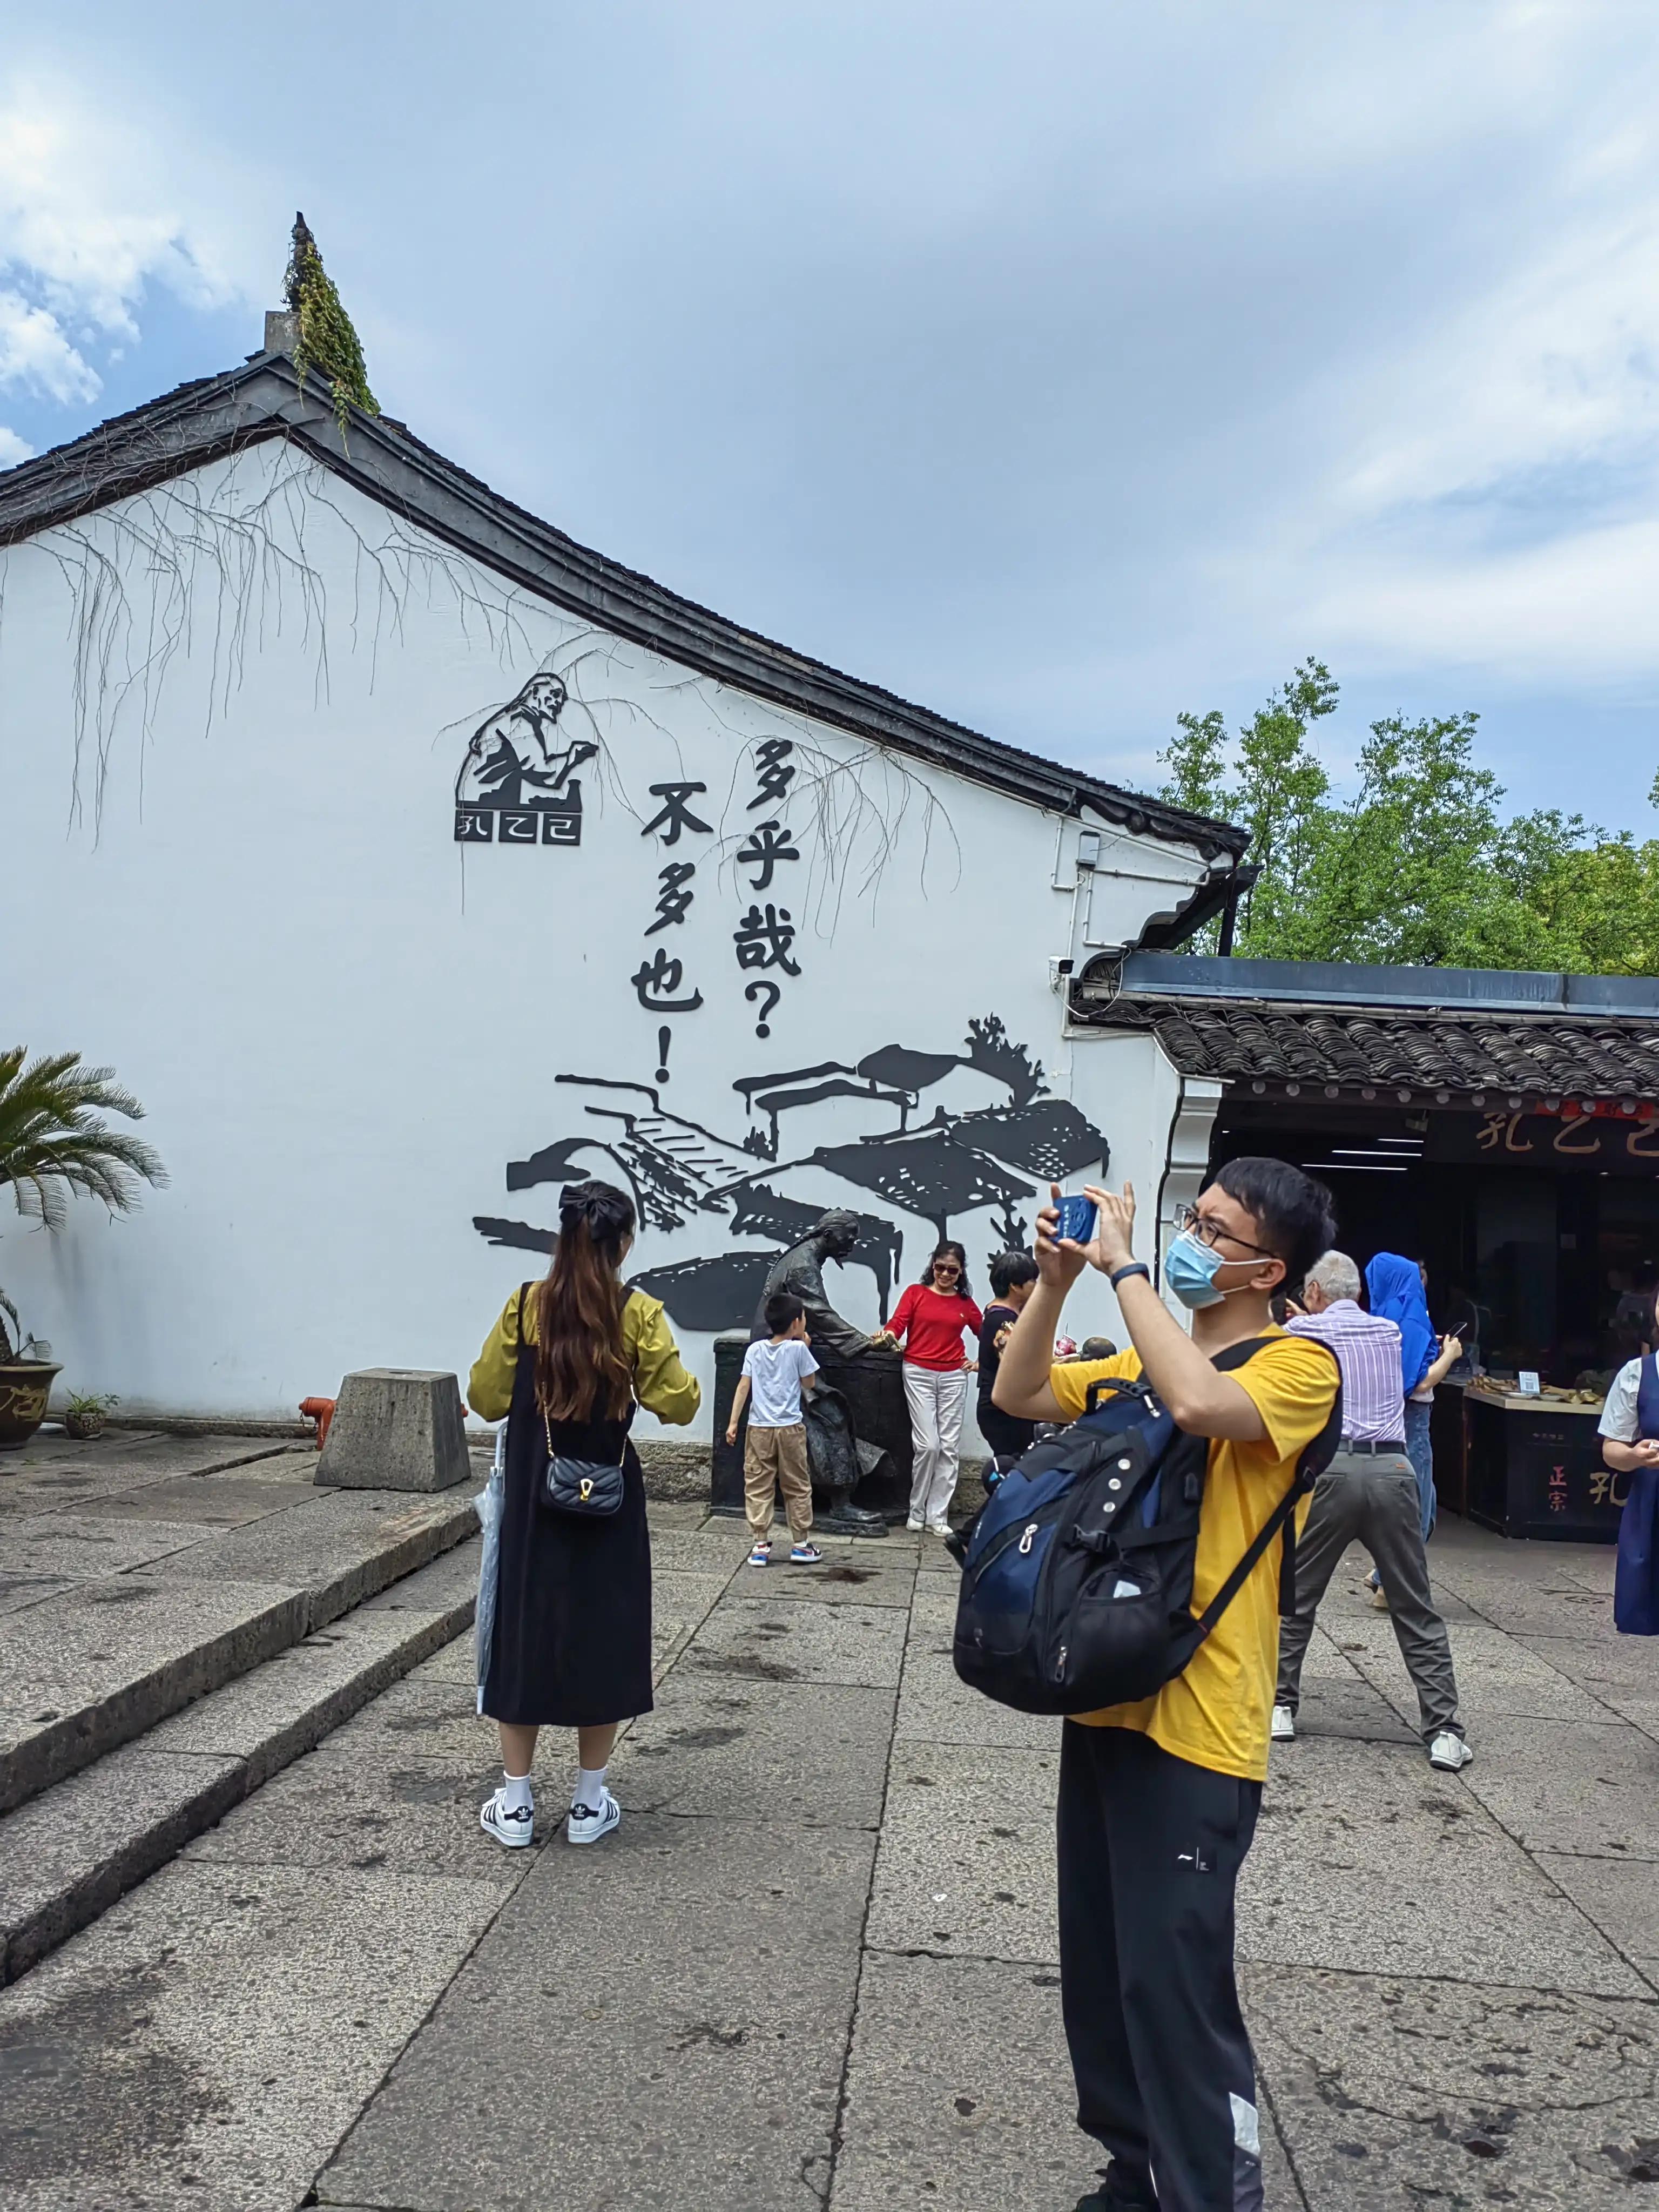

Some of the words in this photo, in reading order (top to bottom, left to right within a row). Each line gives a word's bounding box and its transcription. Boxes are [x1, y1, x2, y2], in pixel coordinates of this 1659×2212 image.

[457, 815, 576, 839] 孔乙己
[1549, 1466, 1567, 1512] 正宗
